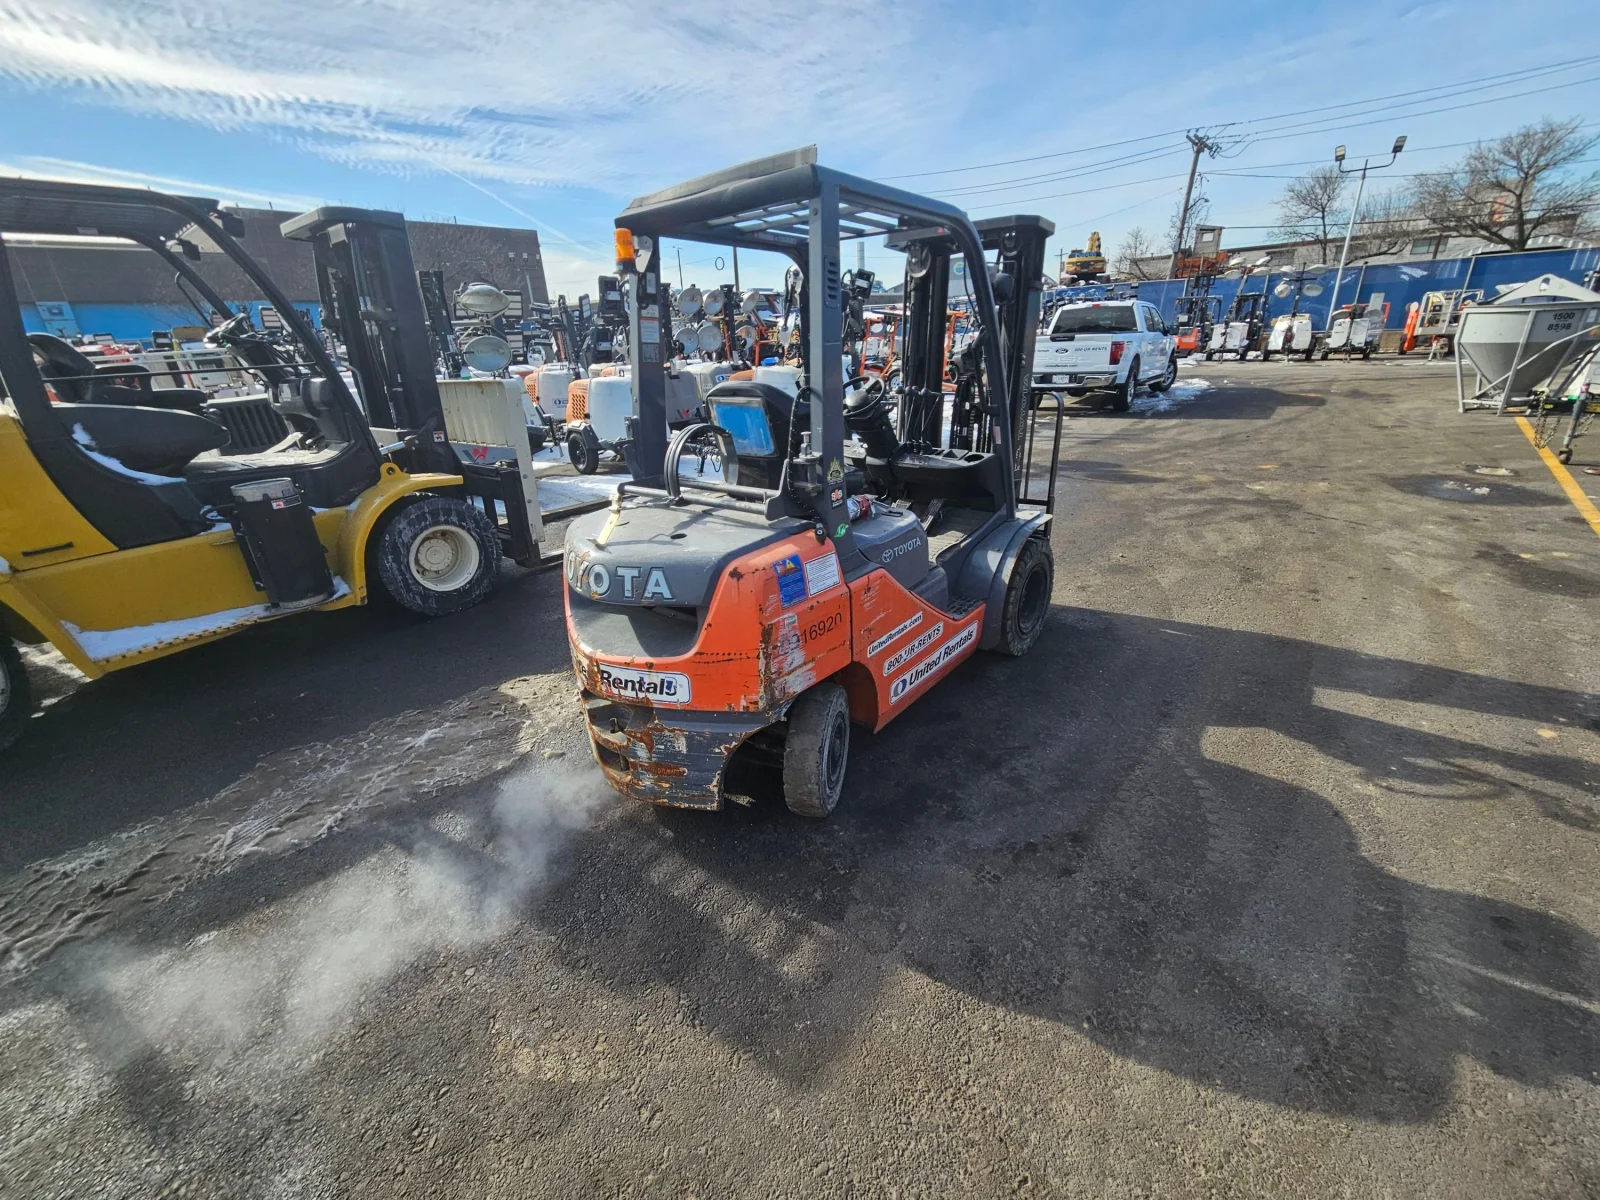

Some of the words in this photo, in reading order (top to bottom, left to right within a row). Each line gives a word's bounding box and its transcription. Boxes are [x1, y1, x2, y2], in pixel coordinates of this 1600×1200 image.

[1547, 323, 1572, 331] 8598
[1553, 312, 1575, 320] 1500
[1017, 373, 1030, 441] TOYOTA
[894, 537, 921, 557] TOYOTA
[567, 550, 677, 601] OYOTA
[868, 614, 922, 655] UnitedRentals.com
[909, 652, 942, 686] United
[942, 629, 974, 661] Rentals
